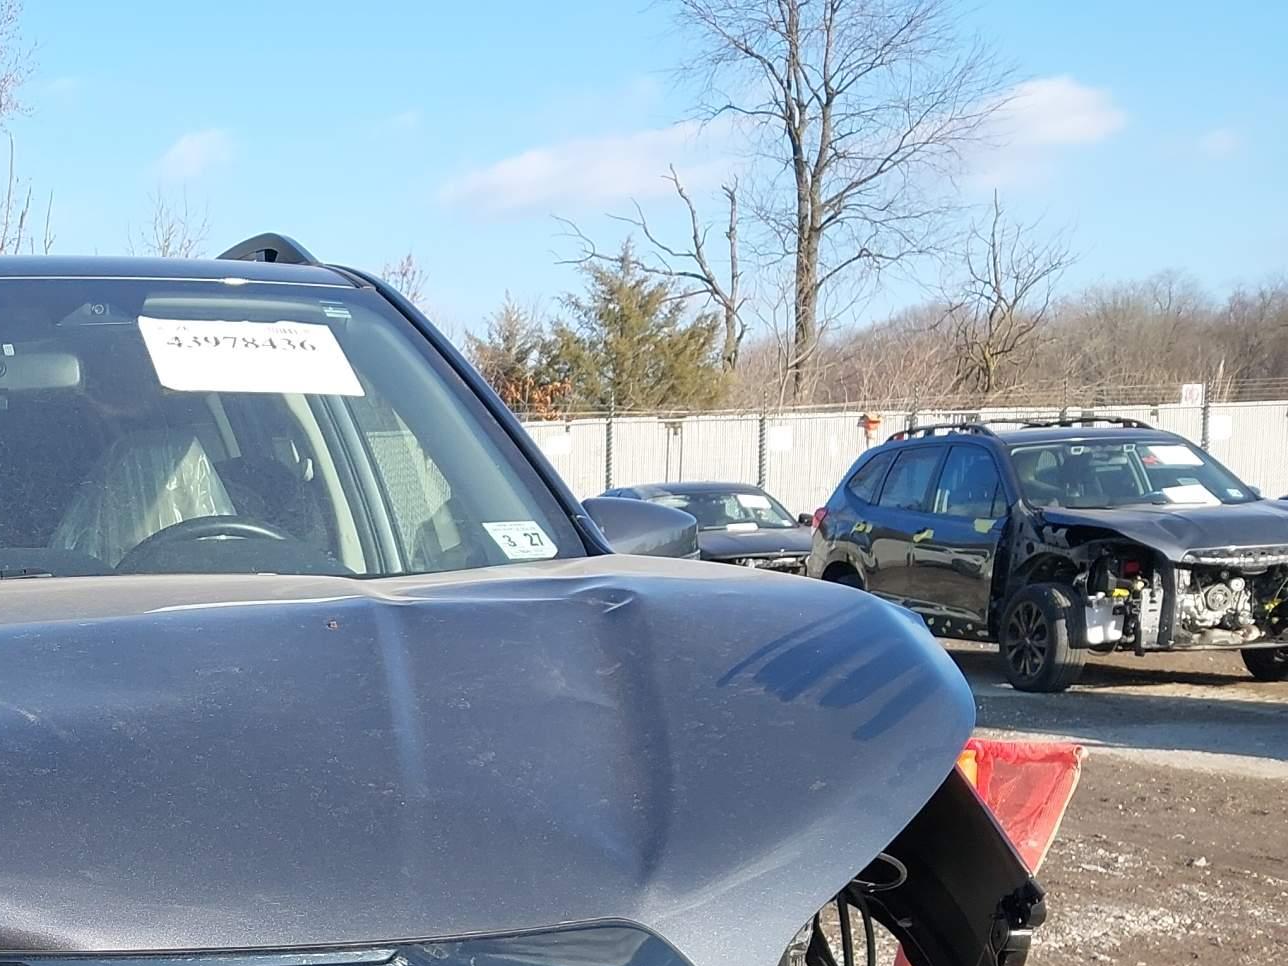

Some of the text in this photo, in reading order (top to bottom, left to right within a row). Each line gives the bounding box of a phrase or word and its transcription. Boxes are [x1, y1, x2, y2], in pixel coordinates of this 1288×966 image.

[166, 335, 317, 351] 43978436
[502, 532, 544, 547] 3 27
